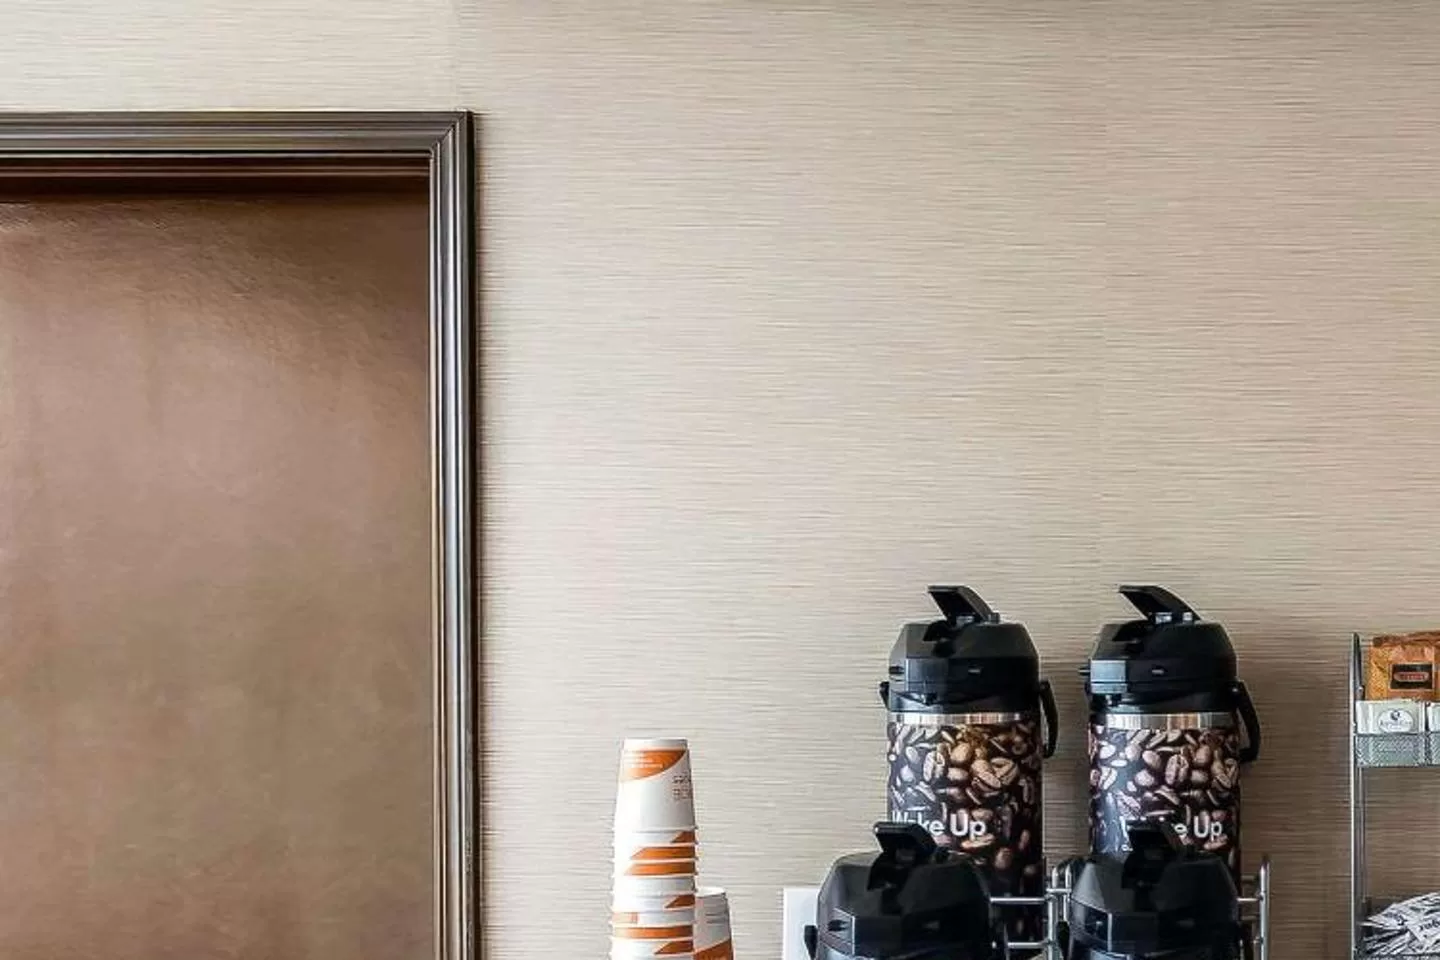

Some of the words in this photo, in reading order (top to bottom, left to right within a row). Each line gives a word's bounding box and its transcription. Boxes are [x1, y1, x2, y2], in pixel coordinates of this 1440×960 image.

[892, 810, 946, 836] Wke
[949, 812, 987, 841] Up
[1193, 815, 1223, 841] Up
